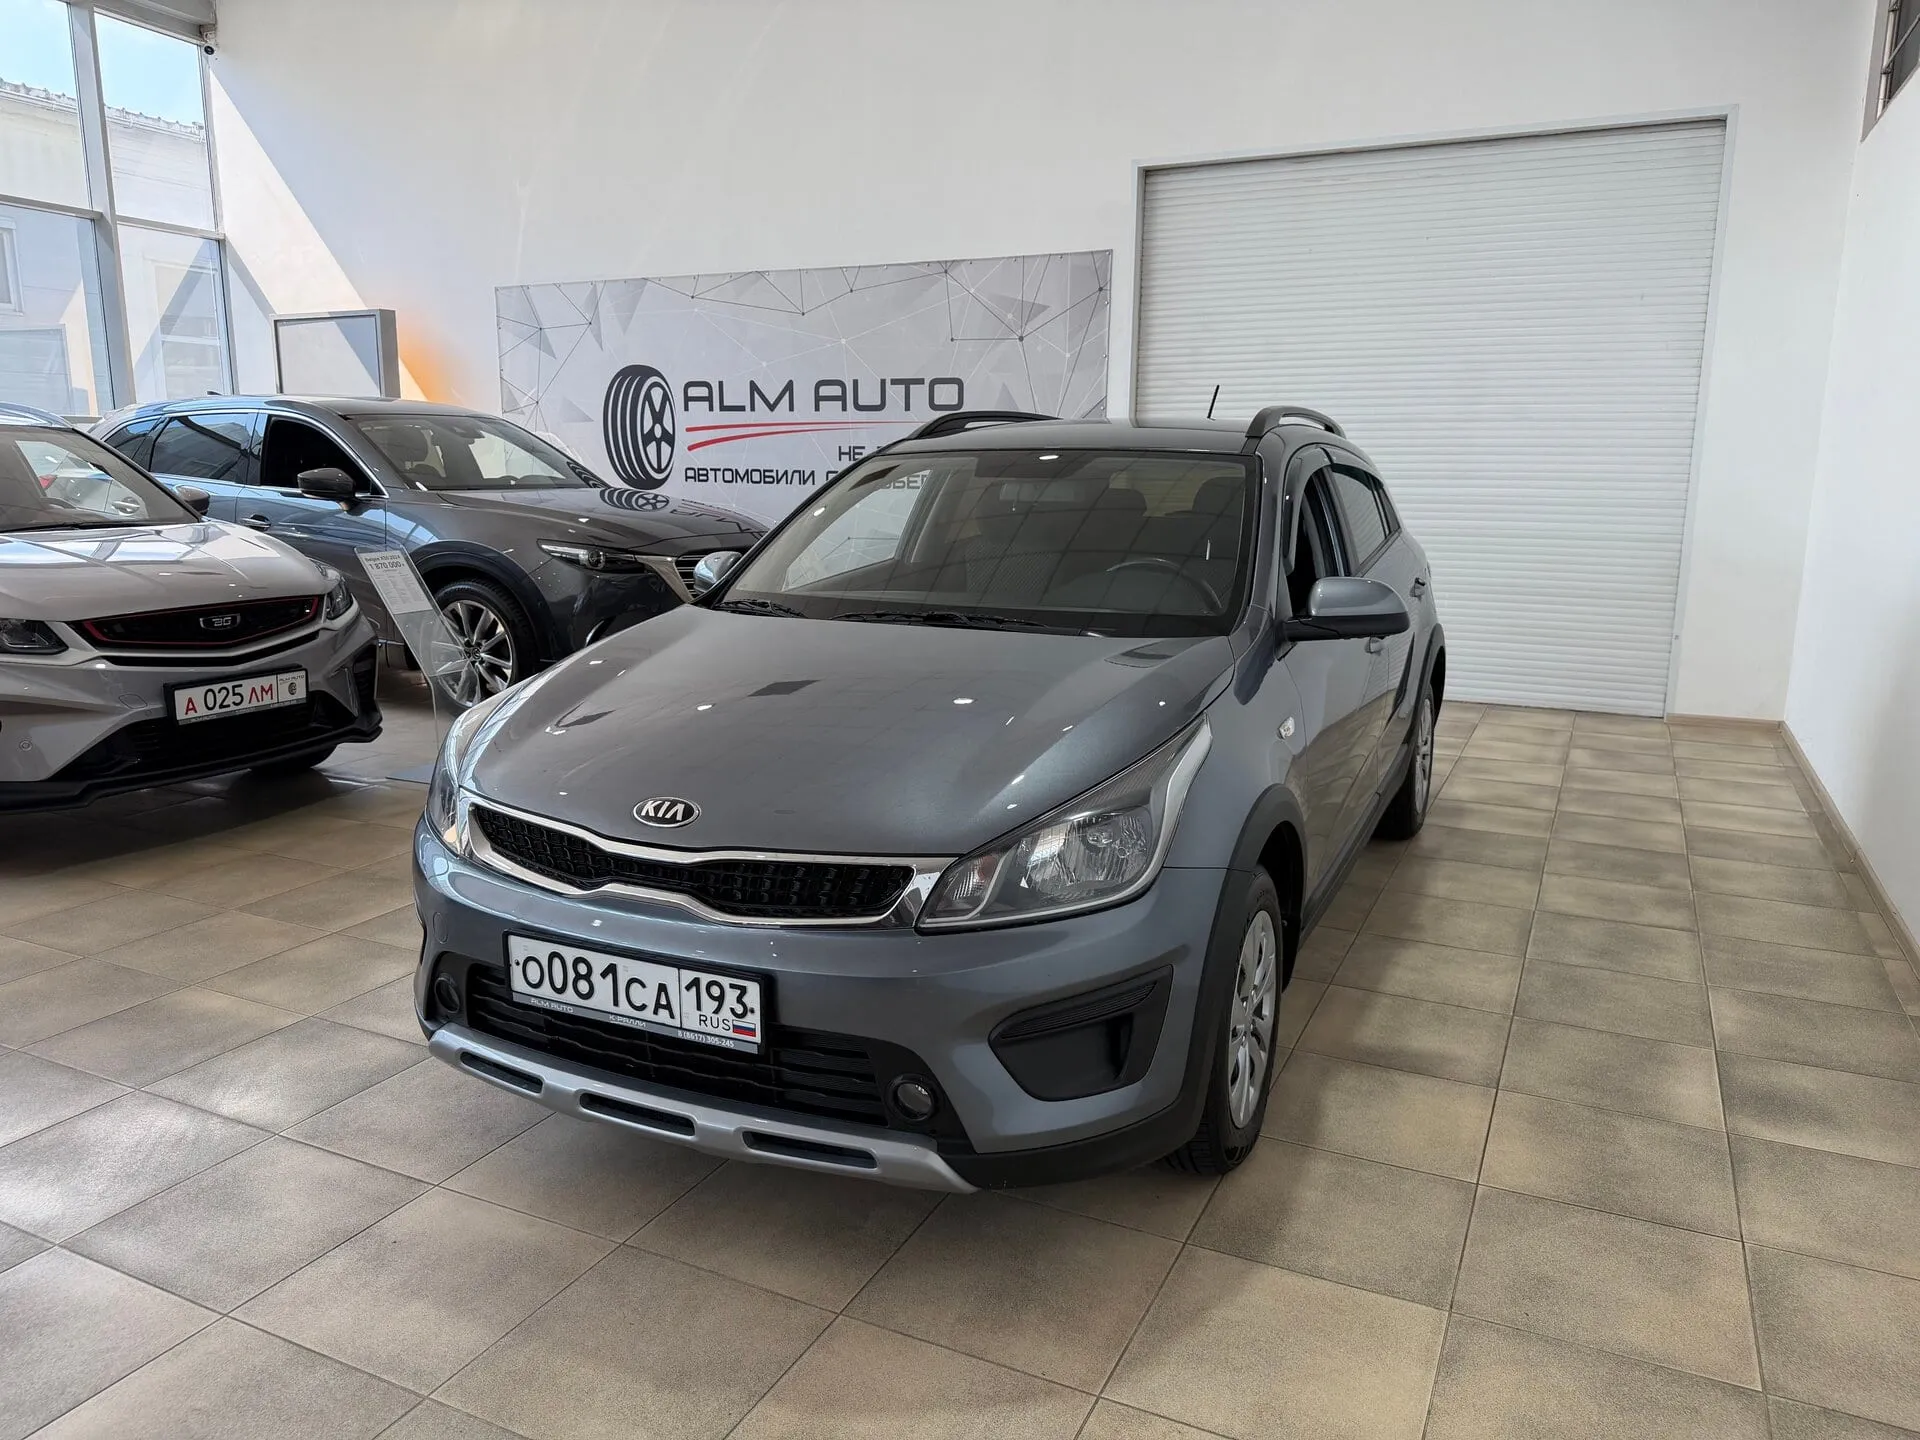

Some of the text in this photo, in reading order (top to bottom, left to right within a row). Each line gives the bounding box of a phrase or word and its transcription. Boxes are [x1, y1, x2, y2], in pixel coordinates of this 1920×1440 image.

[683, 377, 965, 412] ALM AUTO
[838, 445, 865, 461] НЕ
[684, 467, 816, 485] АВТОМОБИЛИ
[203, 684, 244, 711] 025
[640, 800, 685, 821] KIA
[698, 1014, 731, 1032] RUS
